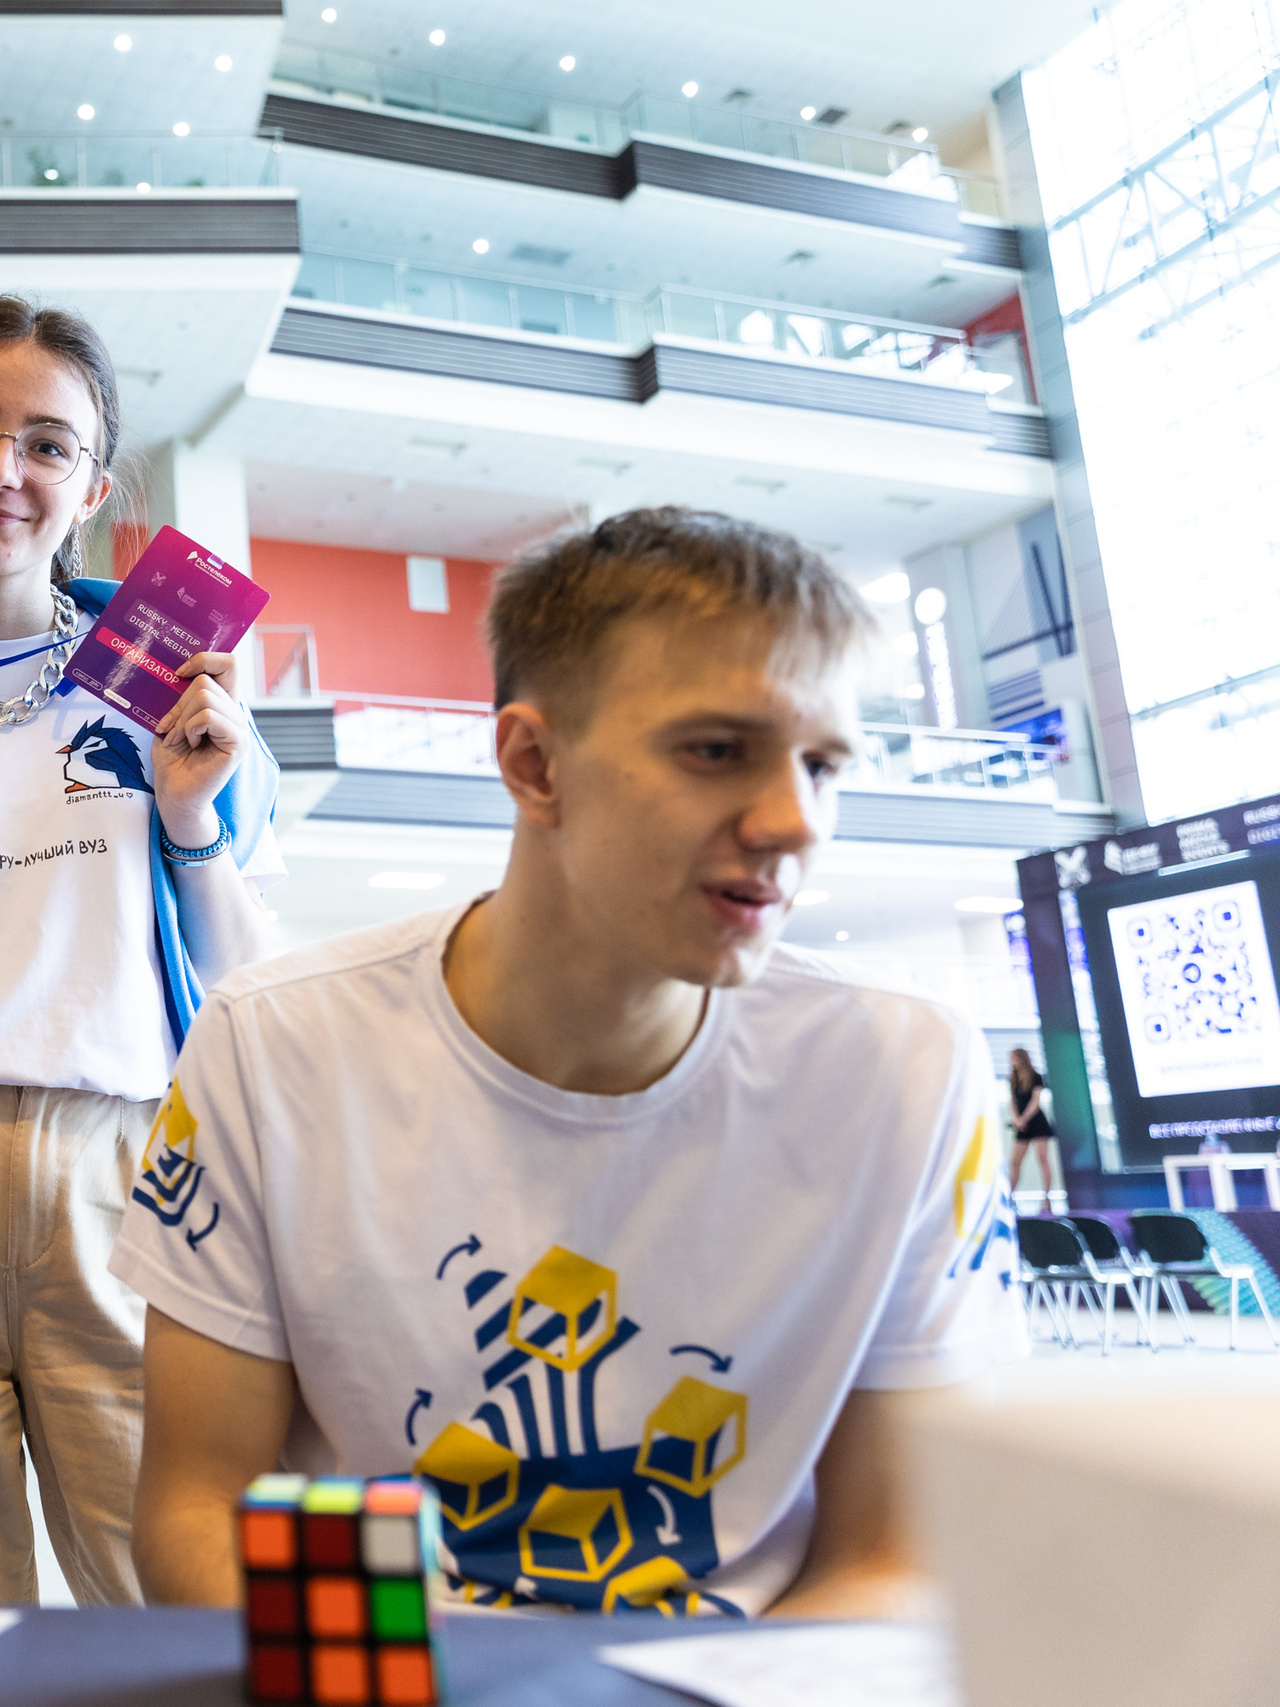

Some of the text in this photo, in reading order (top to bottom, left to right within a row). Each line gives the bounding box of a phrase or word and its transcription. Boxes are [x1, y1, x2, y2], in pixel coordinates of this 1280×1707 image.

[195, 557, 232, 586] Ростелеком
[129, 615, 193, 659] DIGITAL REGION
[137, 604, 200, 646] RUSSKY MEETUP
[111, 637, 179, 684] ОРГАНИЗАТОР
[78, 838, 108, 855] ВУЗ
